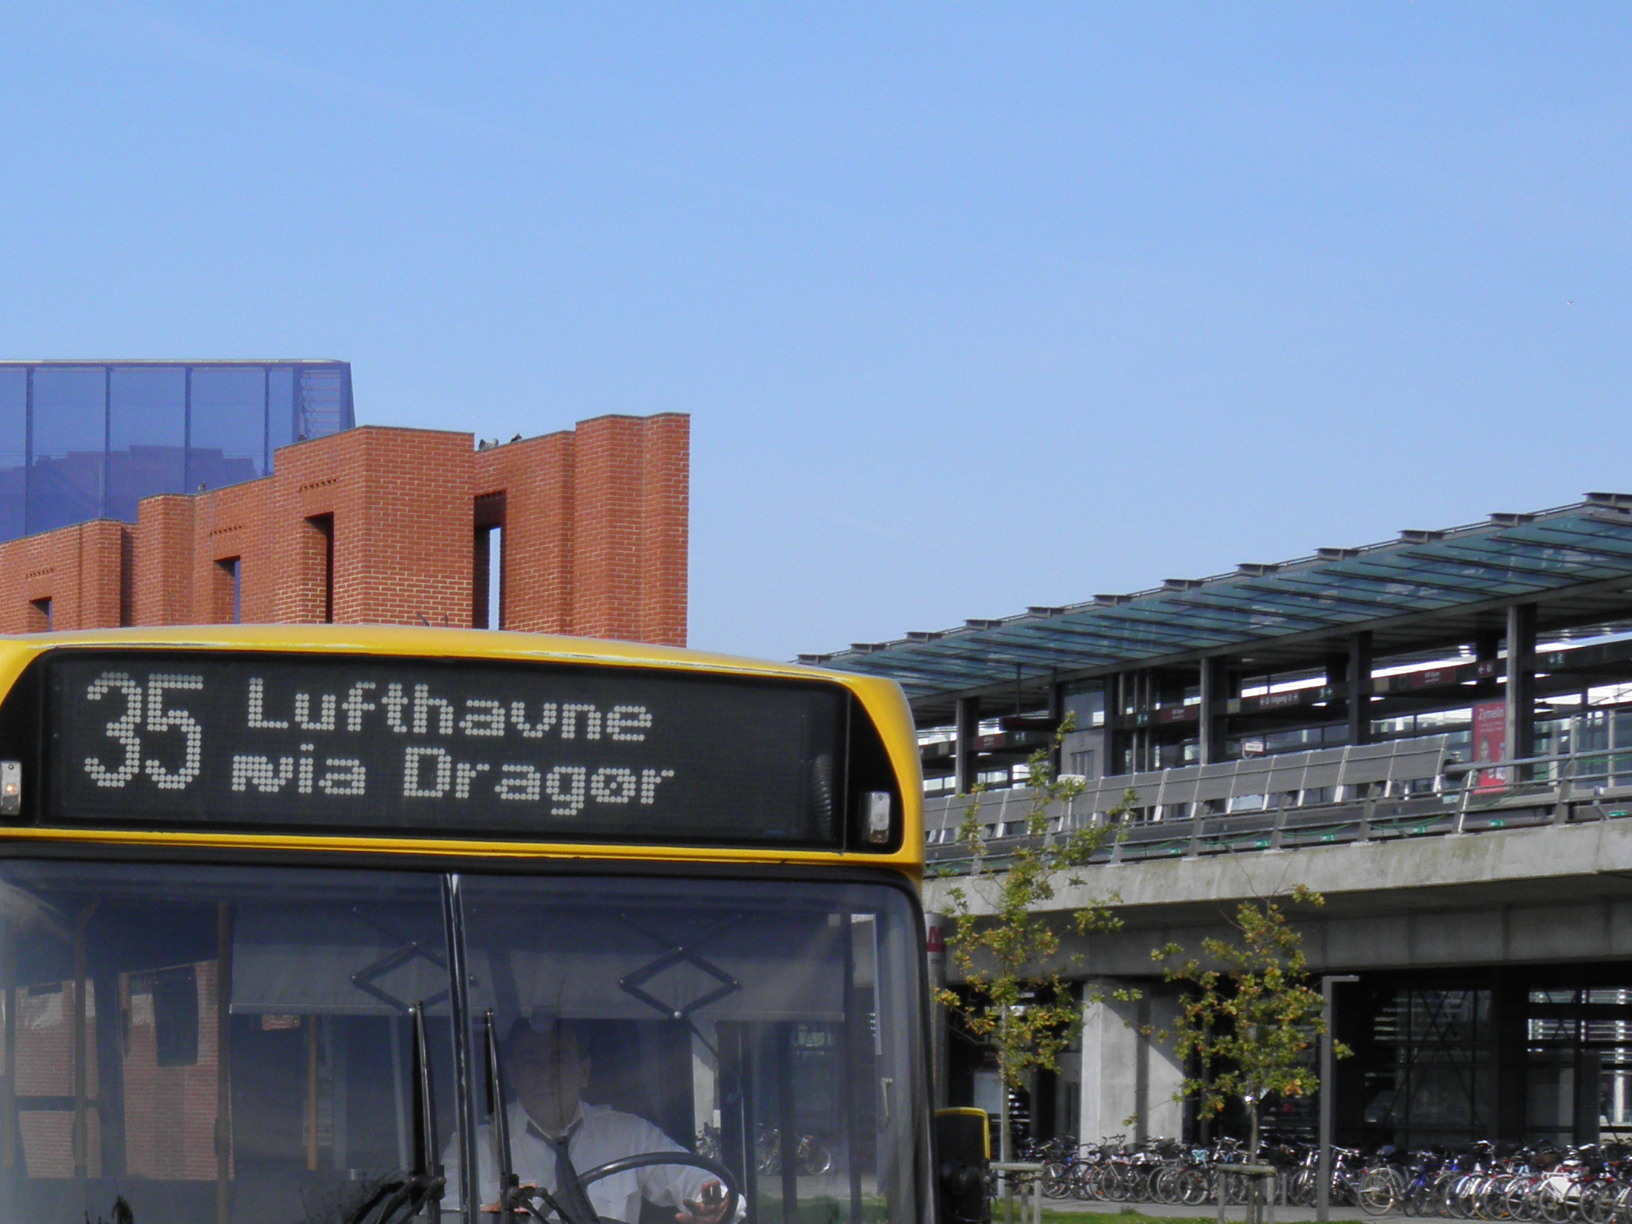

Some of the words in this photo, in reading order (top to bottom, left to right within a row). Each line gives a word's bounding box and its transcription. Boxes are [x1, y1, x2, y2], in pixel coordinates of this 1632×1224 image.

[84, 672, 203, 789] 35
[248, 677, 654, 742] Lufthavne
[404, 746, 674, 816] Dragør
